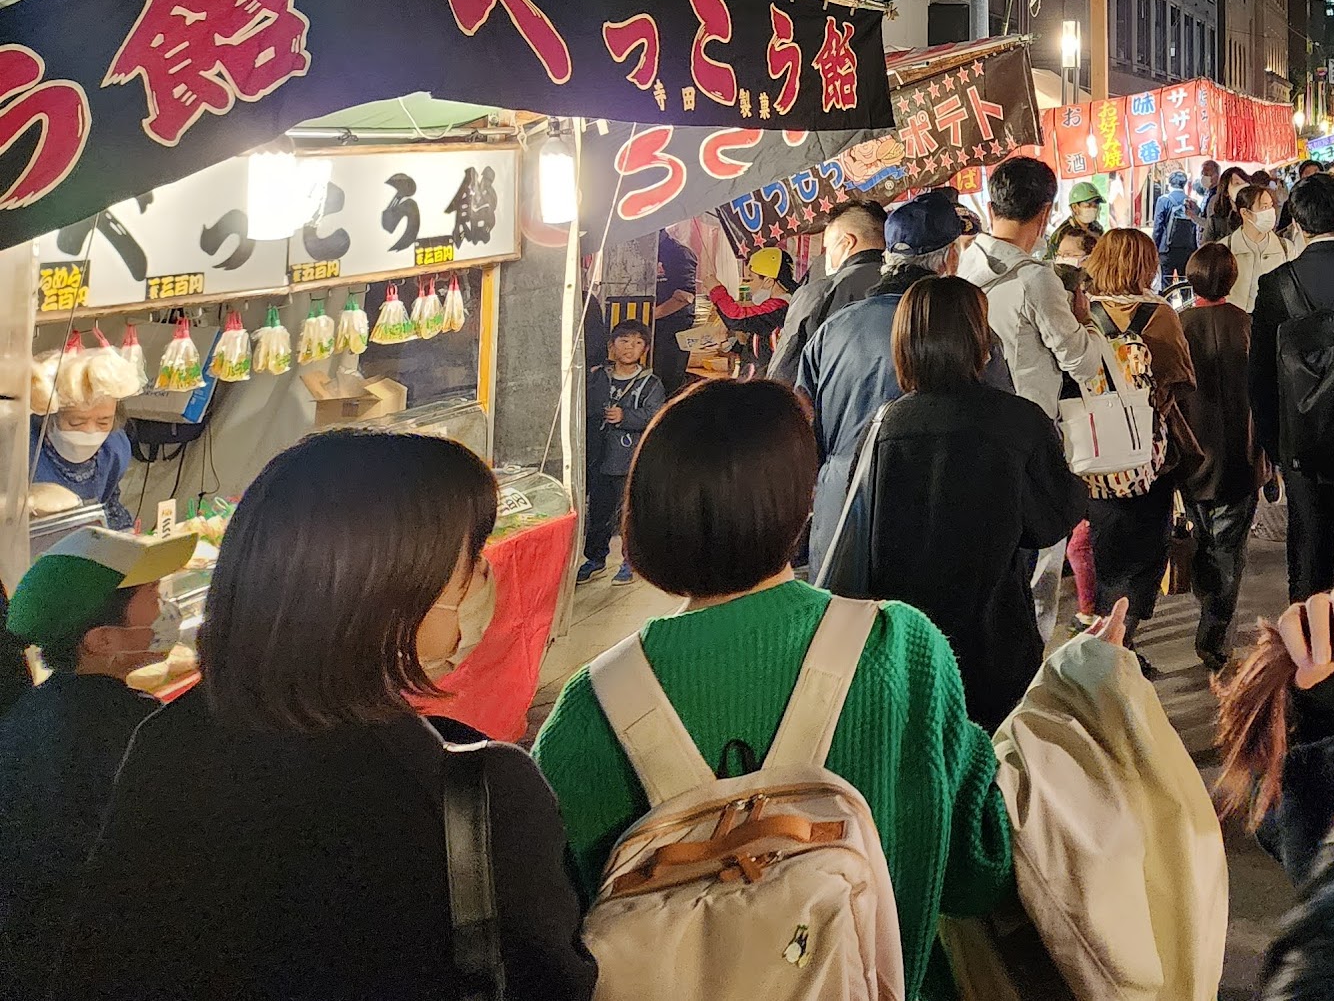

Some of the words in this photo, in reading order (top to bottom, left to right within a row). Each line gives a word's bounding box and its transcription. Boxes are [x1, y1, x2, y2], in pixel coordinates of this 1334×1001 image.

[653, 78, 772, 121] 寺田製菓
[900, 85, 1005, 159] ポテト
[1132, 92, 1161, 163] 味一番
[1167, 87, 1195, 154] サザエ
[1062, 107, 1087, 174] お酒
[1097, 101, 1125, 169] お好み焼
